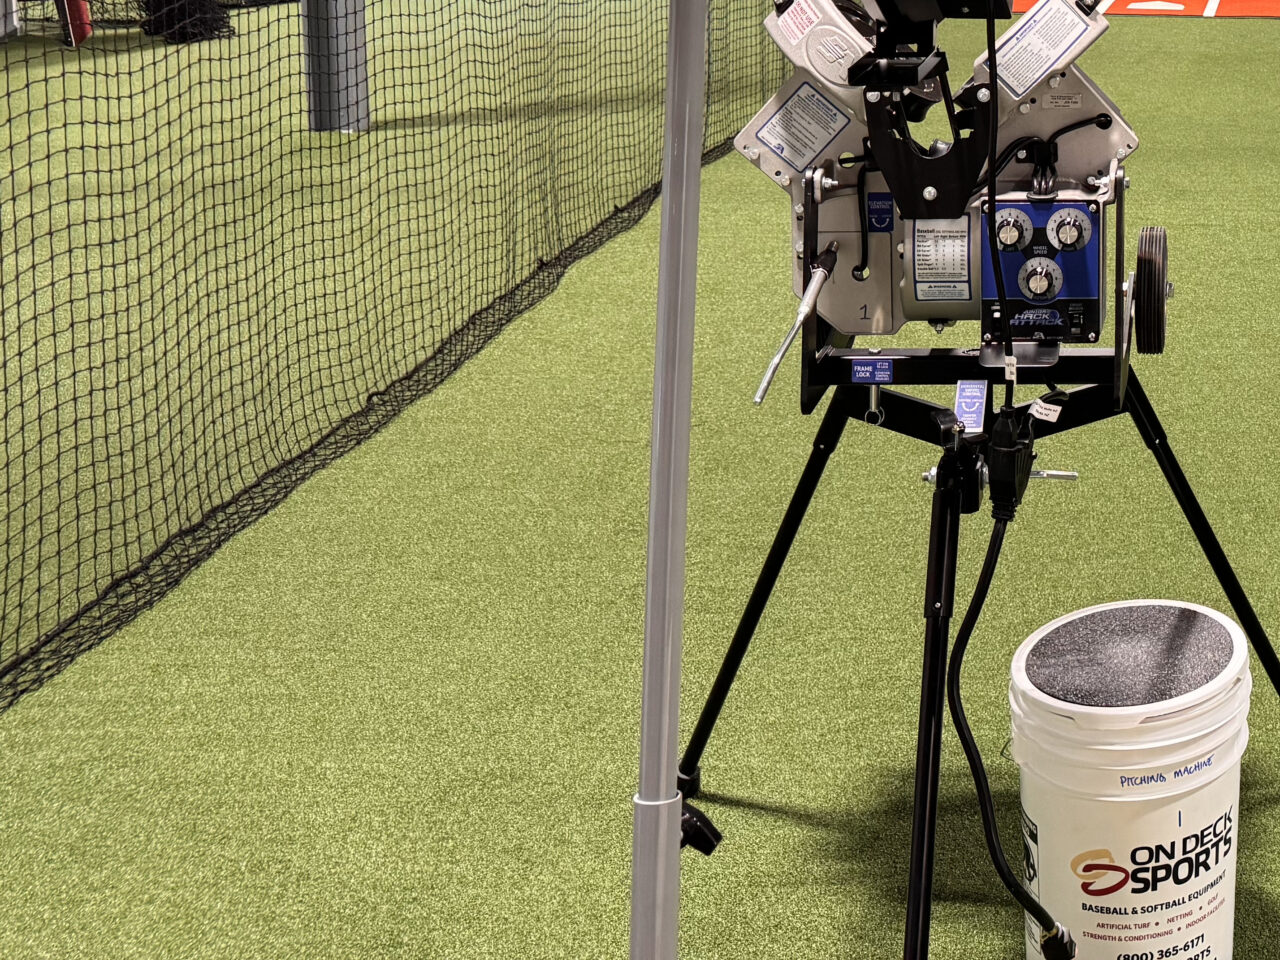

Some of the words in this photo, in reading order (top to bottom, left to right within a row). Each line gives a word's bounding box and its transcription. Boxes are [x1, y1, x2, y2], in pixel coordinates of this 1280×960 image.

[859, 303, 871, 320] 1
[1119, 772, 1167, 788] PITCHING
[1173, 753, 1215, 779] MACHINE
[1130, 841, 1175, 866] ON
[1182, 804, 1233, 856] DECK
[1130, 825, 1232, 894] SPORTS
[1081, 902, 1129, 916] BASEBALL
[1131, 907, 1138, 915] &
[1140, 897, 1186, 914] SOFTBALL
[1188, 869, 1226, 902] EQUIPMENT
[1082, 931, 1117, 942] STRENGTH
[1124, 928, 1174, 942] CONDITIONING
[1096, 921, 1132, 930] ARTIFICIAL
[1134, 921, 1152, 929] TURF
[1166, 910, 1193, 924] NETTING
[1156, 933, 1205, 960] 365-6171
